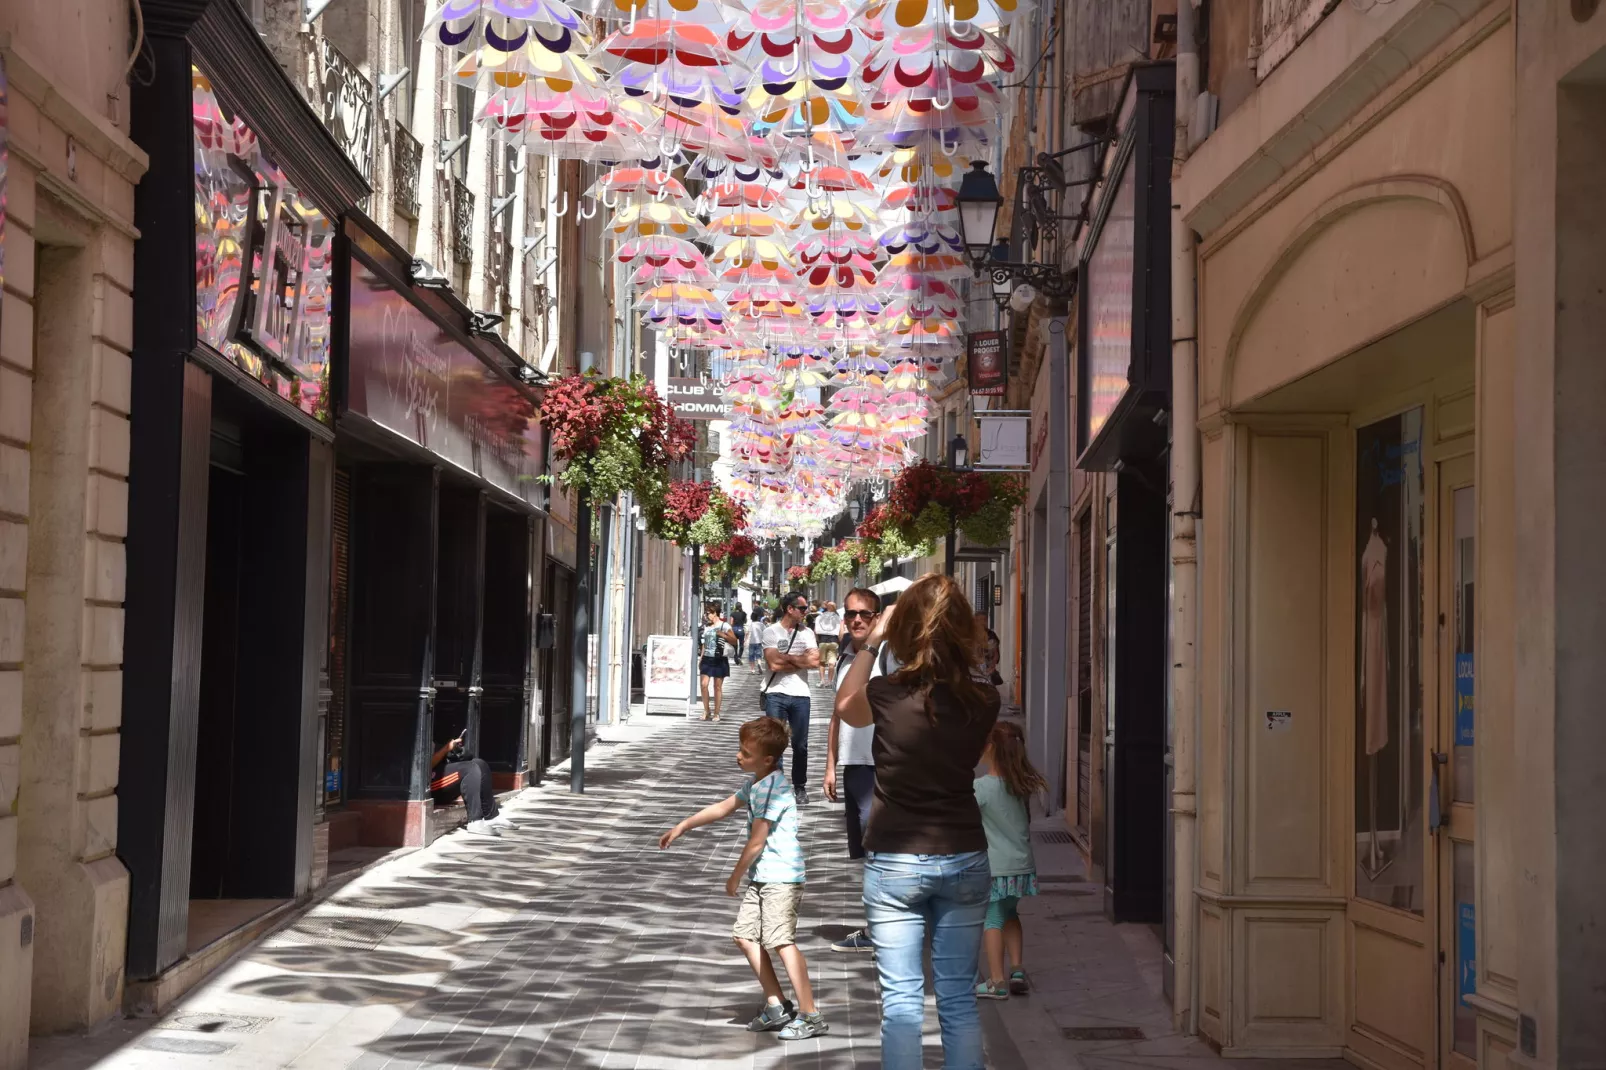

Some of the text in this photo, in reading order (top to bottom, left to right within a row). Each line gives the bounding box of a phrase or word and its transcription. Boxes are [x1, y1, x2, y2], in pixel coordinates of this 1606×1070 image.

[979, 339, 999, 347] LOUER
[973, 345, 1000, 355] PROGEST
[667, 385, 705, 395] CLUB
